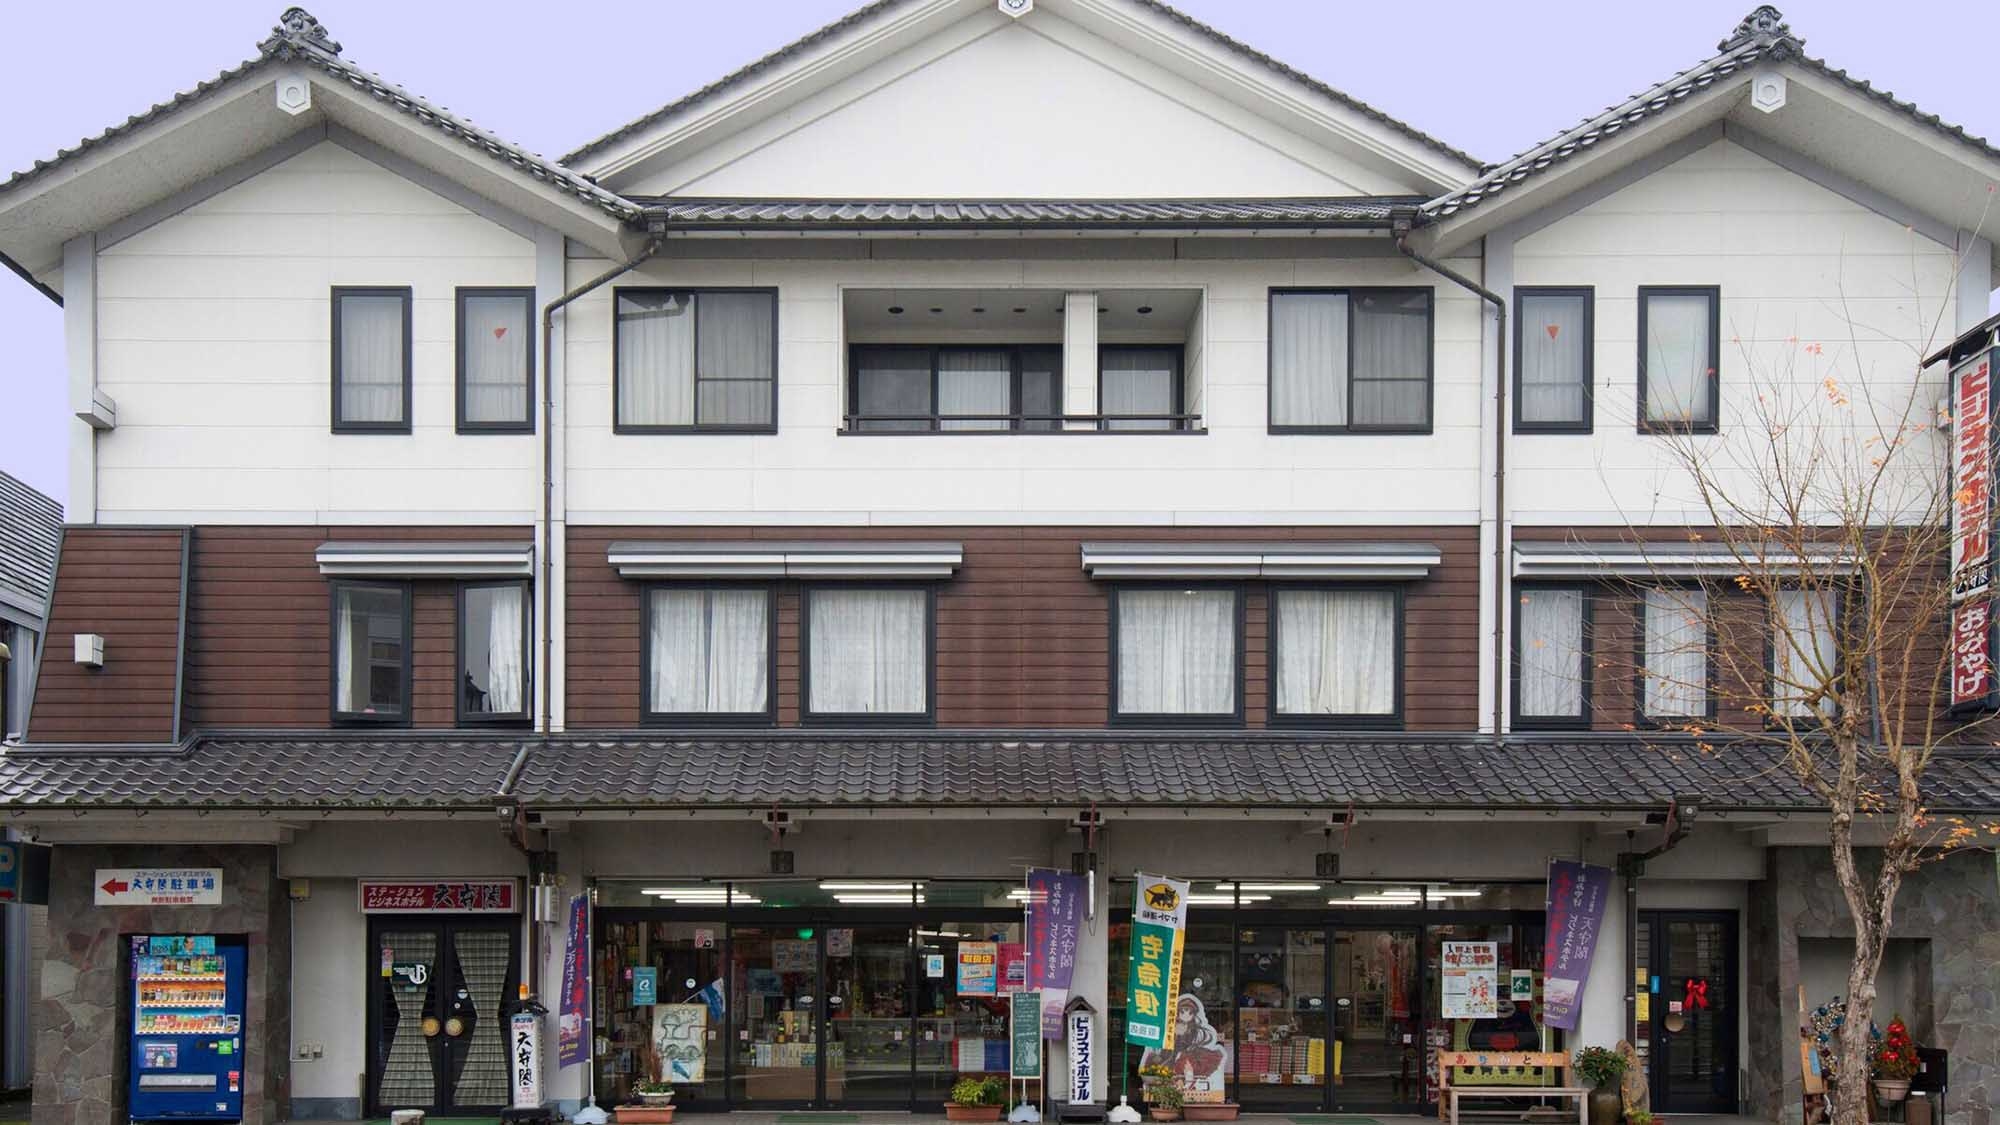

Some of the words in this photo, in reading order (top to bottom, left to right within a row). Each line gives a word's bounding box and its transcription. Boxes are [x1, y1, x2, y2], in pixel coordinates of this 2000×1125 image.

[1958, 608, 1986, 695] おみやげ
[368, 887, 425, 897] ステーション
[368, 896, 425, 907] ビジネスホテル
[1076, 1016, 1090, 1101] ビジネスホテル
